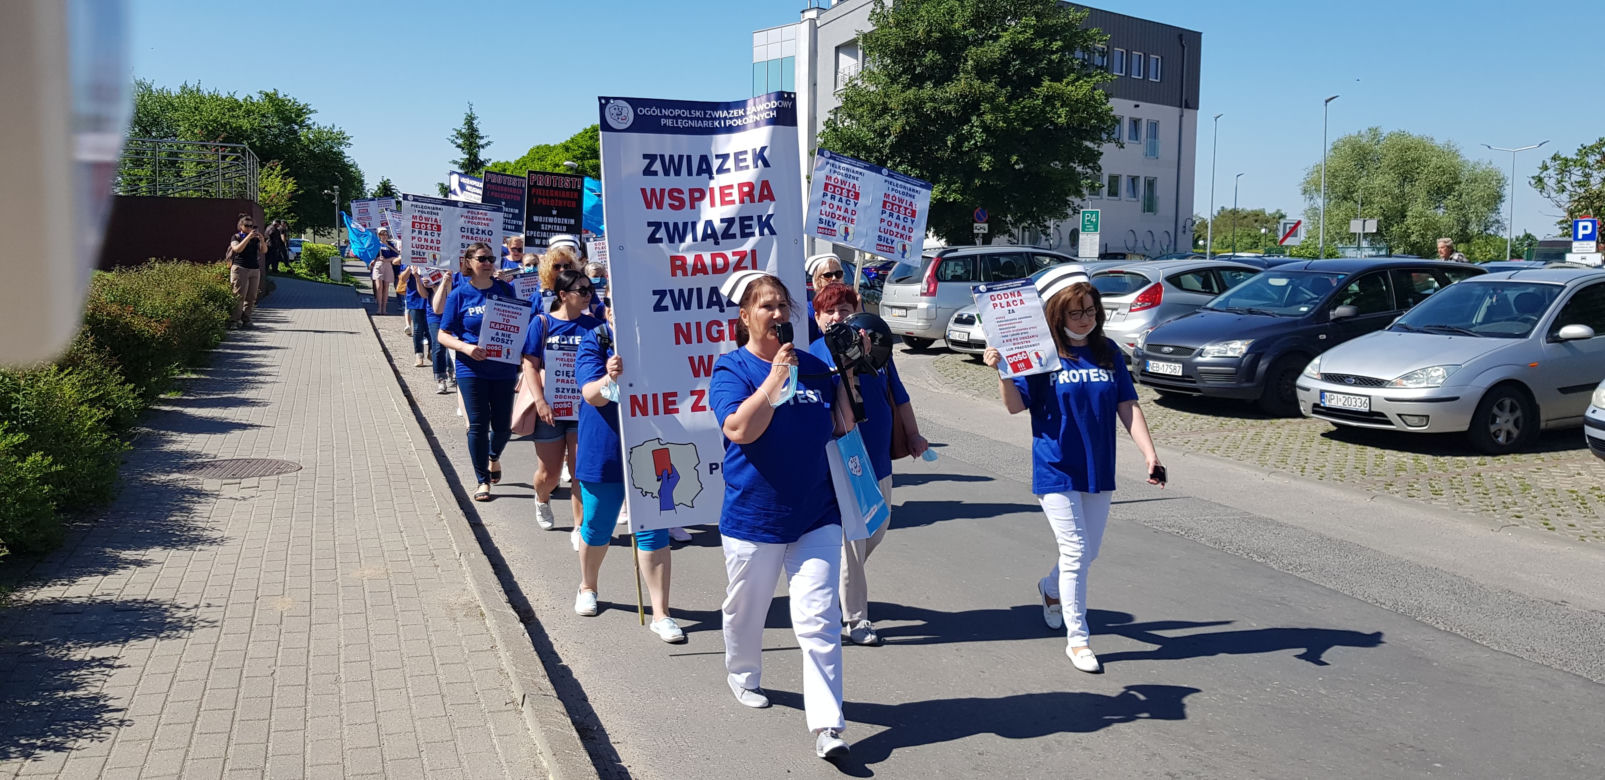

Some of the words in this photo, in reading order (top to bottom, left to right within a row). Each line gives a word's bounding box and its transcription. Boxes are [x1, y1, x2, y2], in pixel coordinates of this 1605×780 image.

[638, 106, 704, 118] OGÓLNOPOLSKI
[706, 108, 744, 118] ZWIĄZEK
[746, 100, 792, 115] ZAWODOWY
[661, 118, 719, 128] PIELĘGNIAREK
[726, 110, 776, 128] POŁOŻNYCH
[642, 146, 772, 180] ZWIĄZEK
[530, 173, 582, 189] PROTEST!
[825, 175, 860, 191] MÓWIĄ:
[640, 180, 776, 210] WSPIERA
[828, 184, 856, 199] DOŚĆ
[822, 192, 858, 208] PRACY
[821, 200, 856, 216] PONAD
[886, 202, 913, 217] DOŚĆ
[818, 218, 836, 228] SIŁY
[820, 209, 855, 225] LUDZKIE
[881, 210, 915, 225] PRACY
[1085, 213, 1096, 224] P4
[415, 222, 438, 230] DOŚĆ
[460, 226, 493, 236] CIĘŻKO
[647, 214, 776, 246] ZWIĄZEK
[880, 218, 913, 233] PONAD
[1578, 221, 1592, 240] P
[411, 236, 440, 244] PONAD
[412, 229, 441, 238] PRACY
[461, 234, 492, 243] PRACUJĄ
[877, 235, 894, 245] SIŁY
[879, 227, 912, 242] LUDZKIE
[411, 243, 440, 251] LUDZKIE
[670, 249, 758, 278] RADZI
[652, 286, 740, 312] ZWIĄ
[990, 290, 1022, 301] GODNA
[992, 299, 1025, 309] PŁACA
[490, 322, 519, 332] KAPITAŁ
[491, 336, 514, 345] KOSZT
[1008, 352, 1027, 363] DOŚĆ
[1049, 369, 1116, 386] PROTEST
[630, 392, 679, 417] NIE
[1342, 396, 1368, 408] 20336
